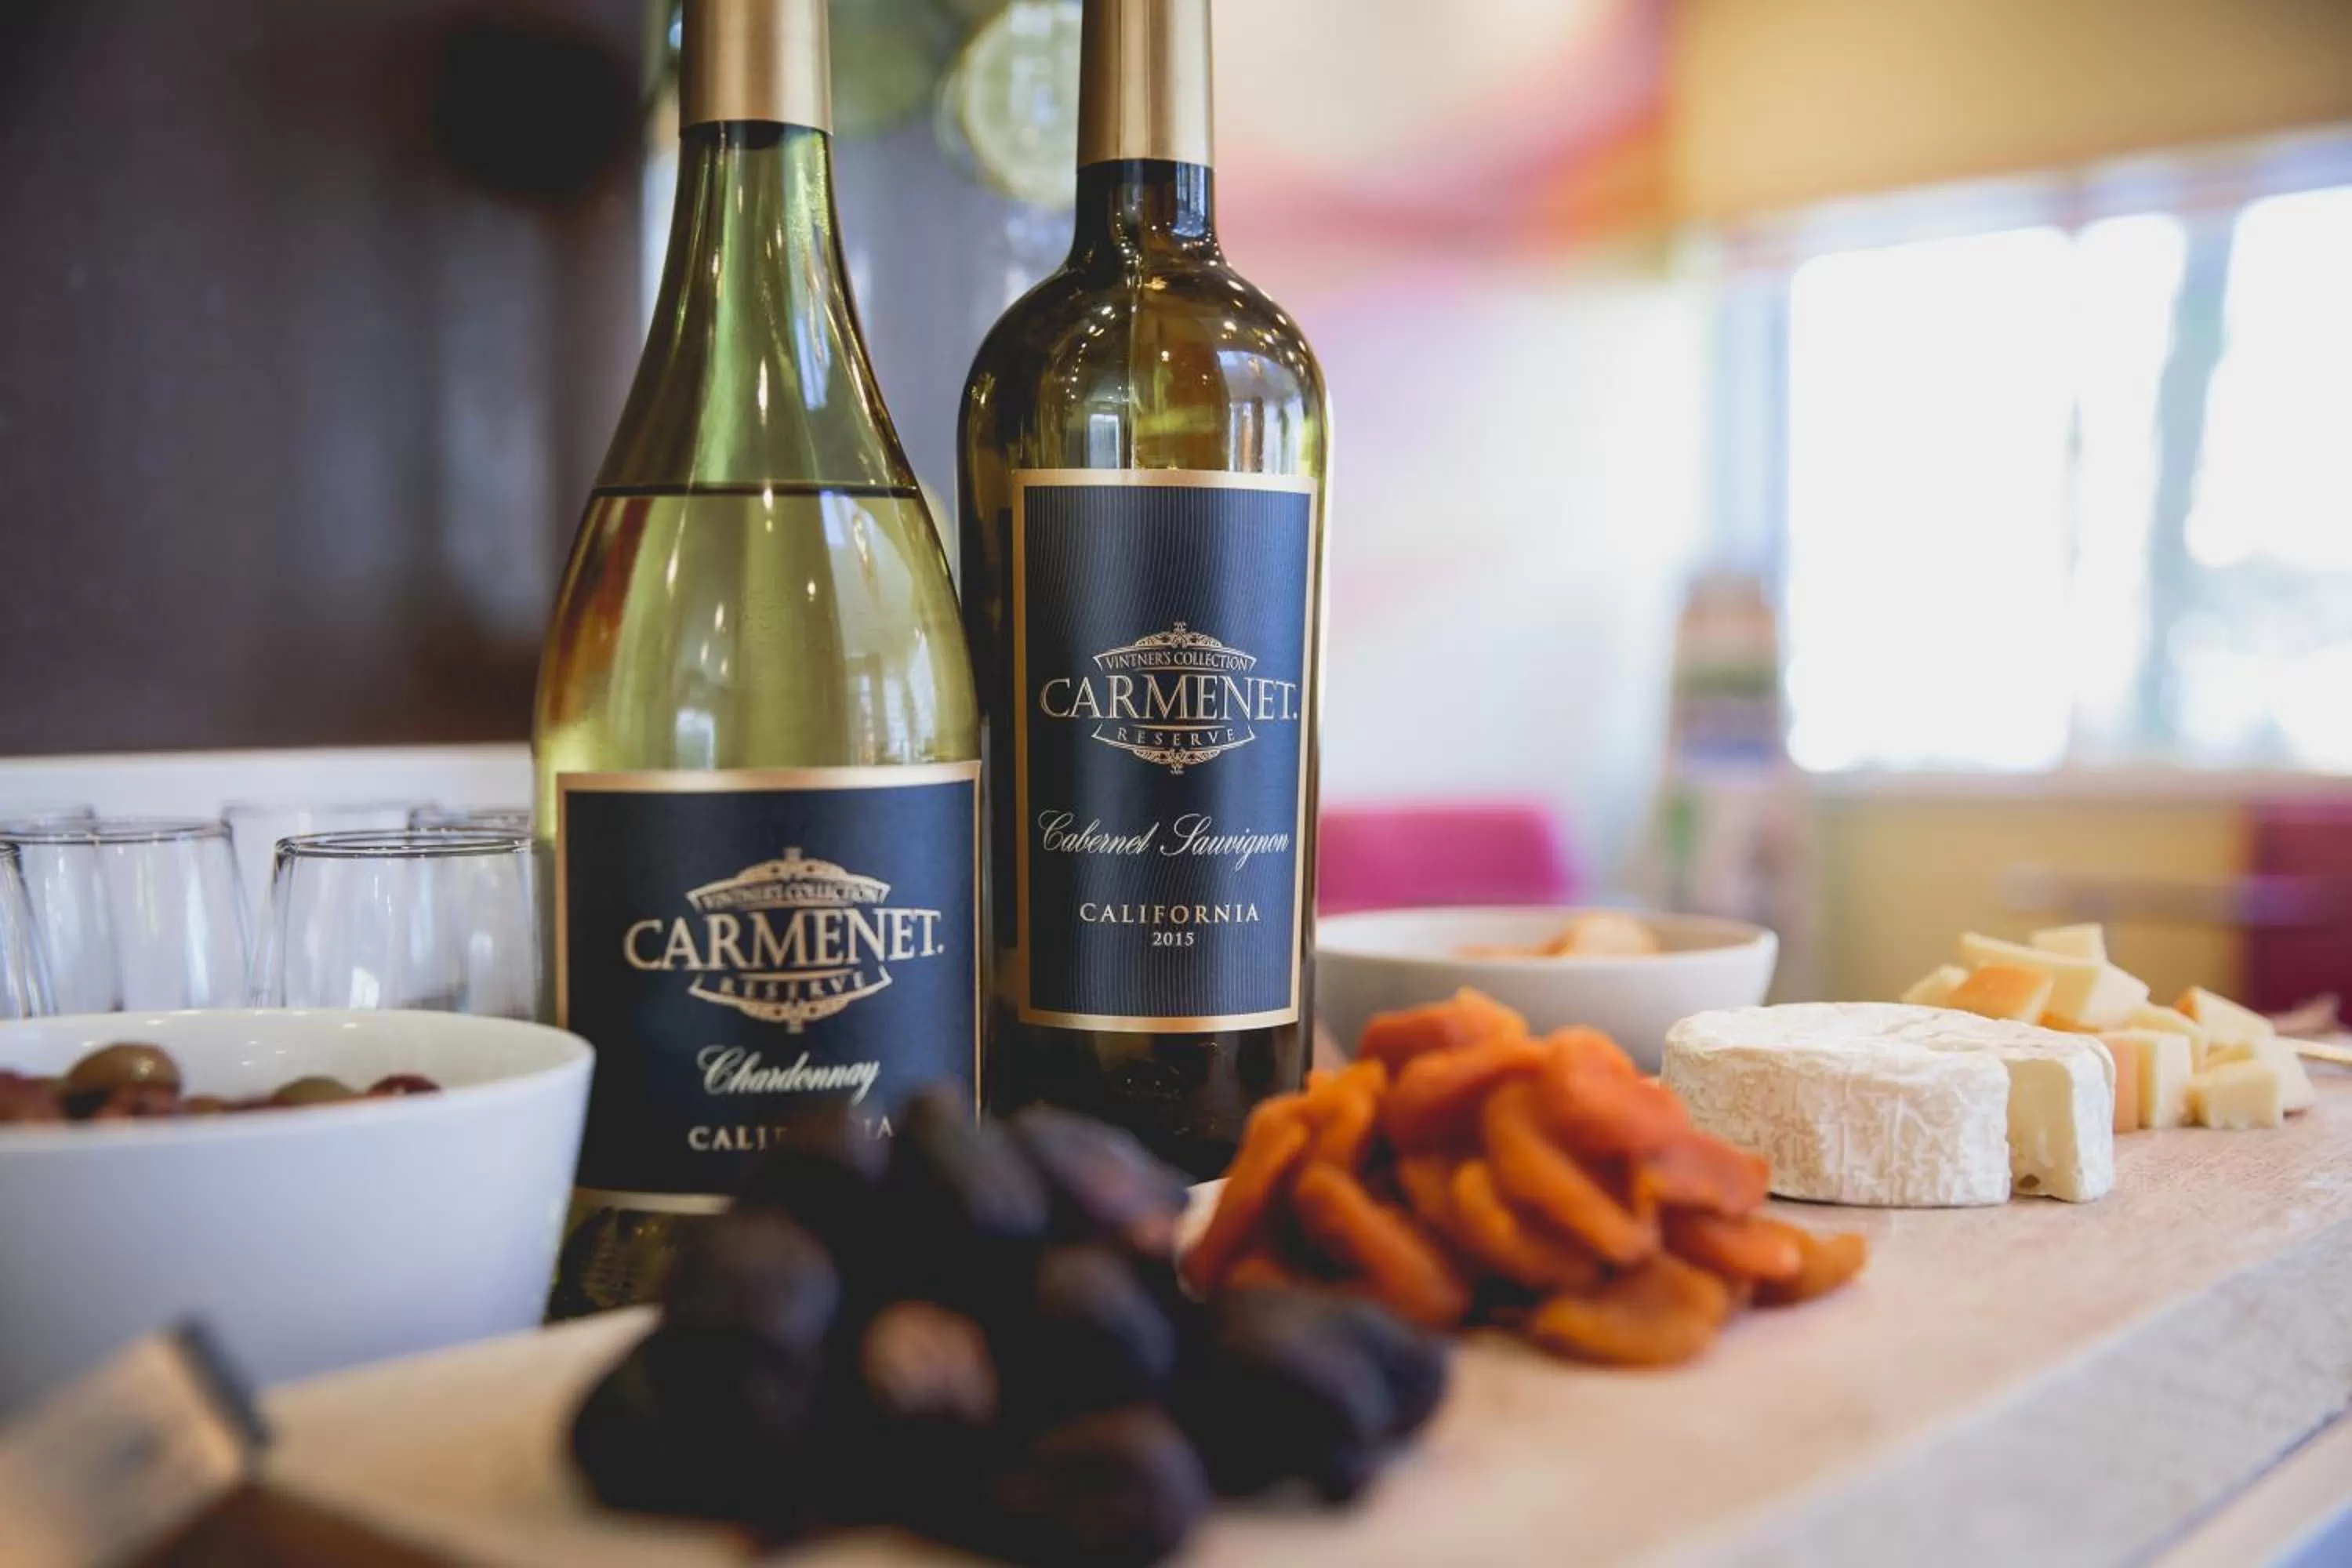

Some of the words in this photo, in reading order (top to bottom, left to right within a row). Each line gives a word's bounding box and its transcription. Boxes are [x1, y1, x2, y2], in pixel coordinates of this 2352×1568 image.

[1174, 652, 1247, 670] COLLECTION
[1117, 728, 1235, 746] RESERVE
[1038, 810, 1160, 855] Cabernet
[1160, 813, 1289, 872] Sauvignon
[1080, 903, 1261, 923] CALIFORNIA
[1152, 932, 1194, 946] 2015
[697, 1046, 880, 1105] Chardonnay
[688, 1116, 894, 1151] CALIIA
